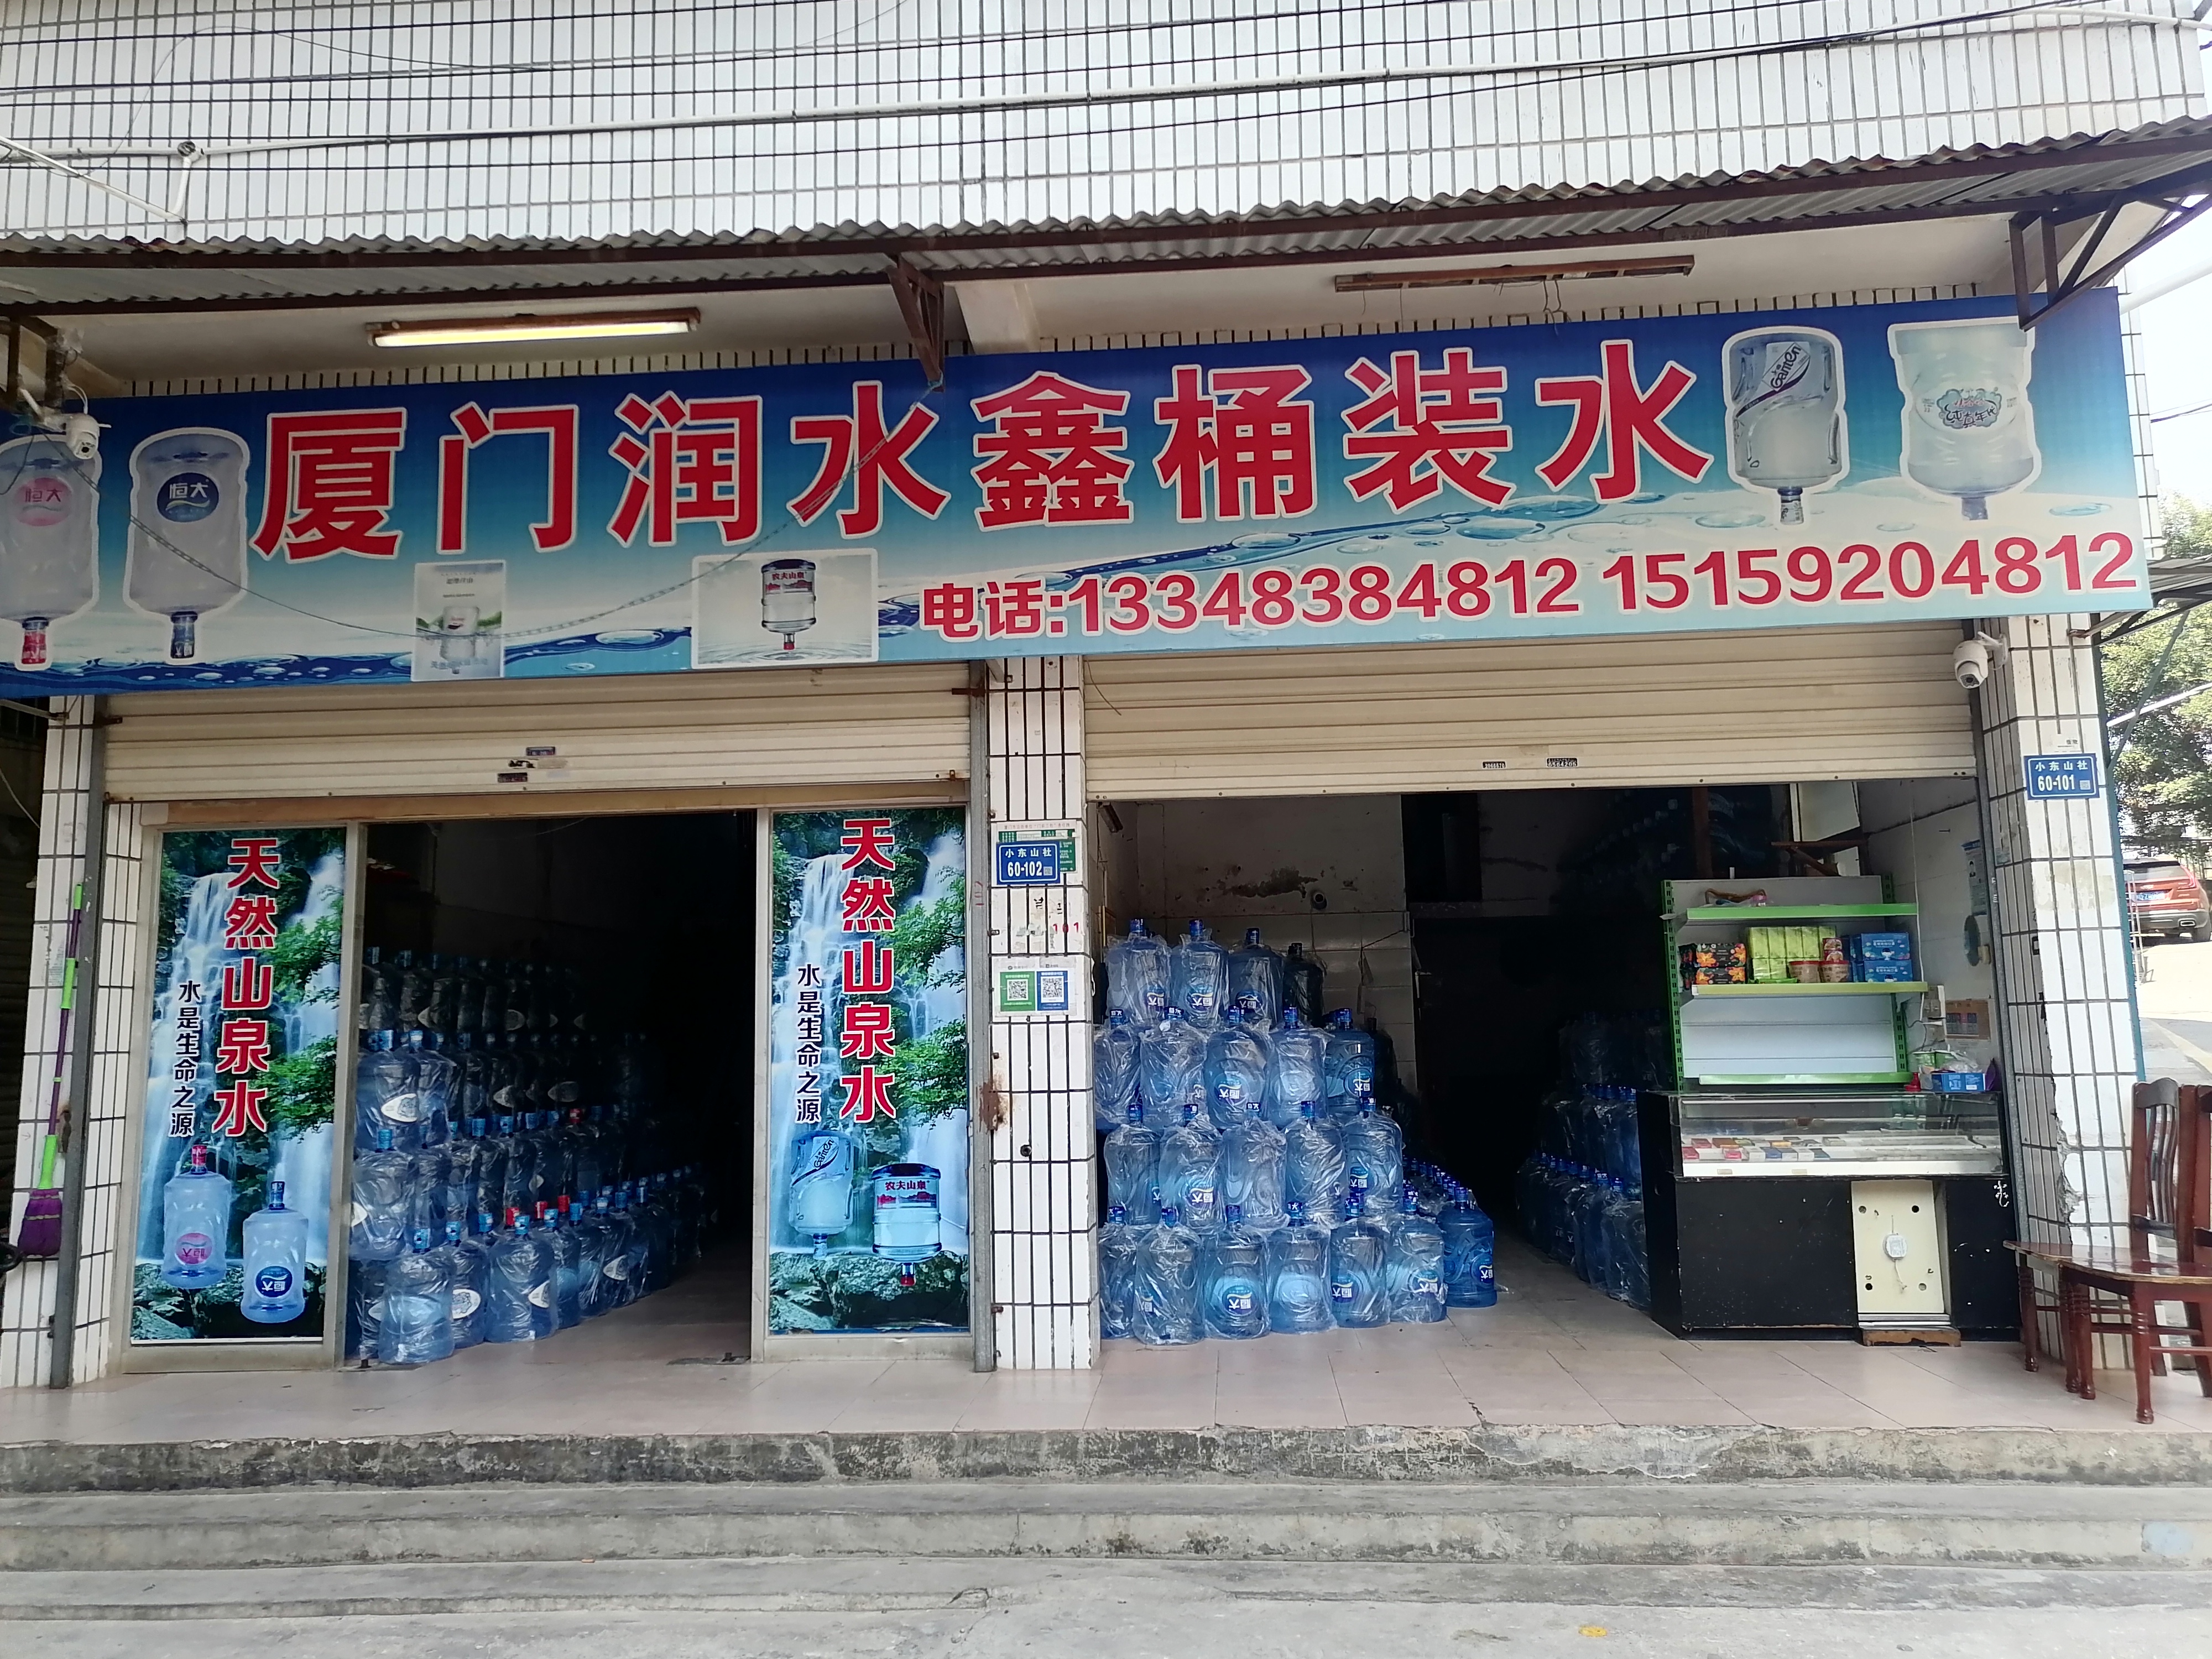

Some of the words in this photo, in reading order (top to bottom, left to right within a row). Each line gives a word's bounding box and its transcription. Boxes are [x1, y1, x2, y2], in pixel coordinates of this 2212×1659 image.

[1945, 405, 1998, 429] 纯真年代
[251, 341, 1713, 562] 厦门润水鑫桶装水
[25, 488, 63, 502] 恒大
[170, 482, 208, 499] 恒大
[772, 572, 805, 580] 农夫山泉
[1601, 532, 2137, 611] 15159204812
[2035, 760, 2088, 771] 小东山社
[2038, 774, 2074, 791] 60-101
[1005, 847, 1052, 858] 小东山社
[1008, 860, 1042, 877] 60-102
[1053, 922, 1079, 935] 101
[839, 818, 896, 1123] 天然山泉水
[212, 838, 280, 1137] 天然山泉水
[1192, 997, 1213, 1006] 恒大
[797, 964, 822, 1122] 水是生命之源
[170, 980, 200, 1136] 水是生命之源
[1219, 1088, 1240, 1099] 恒大
[885, 1180, 927, 1191] 农夫山泉
[1350, 1178, 1368, 1188] 恒大
[1192, 1192, 1213, 1203] 恒大
[182, 1248, 205, 1257] 恒大
[262, 1281, 285, 1292] 恒大
[1332, 1287, 1352, 1298] 恒大
[1229, 1299, 1251, 1310] 恒大
